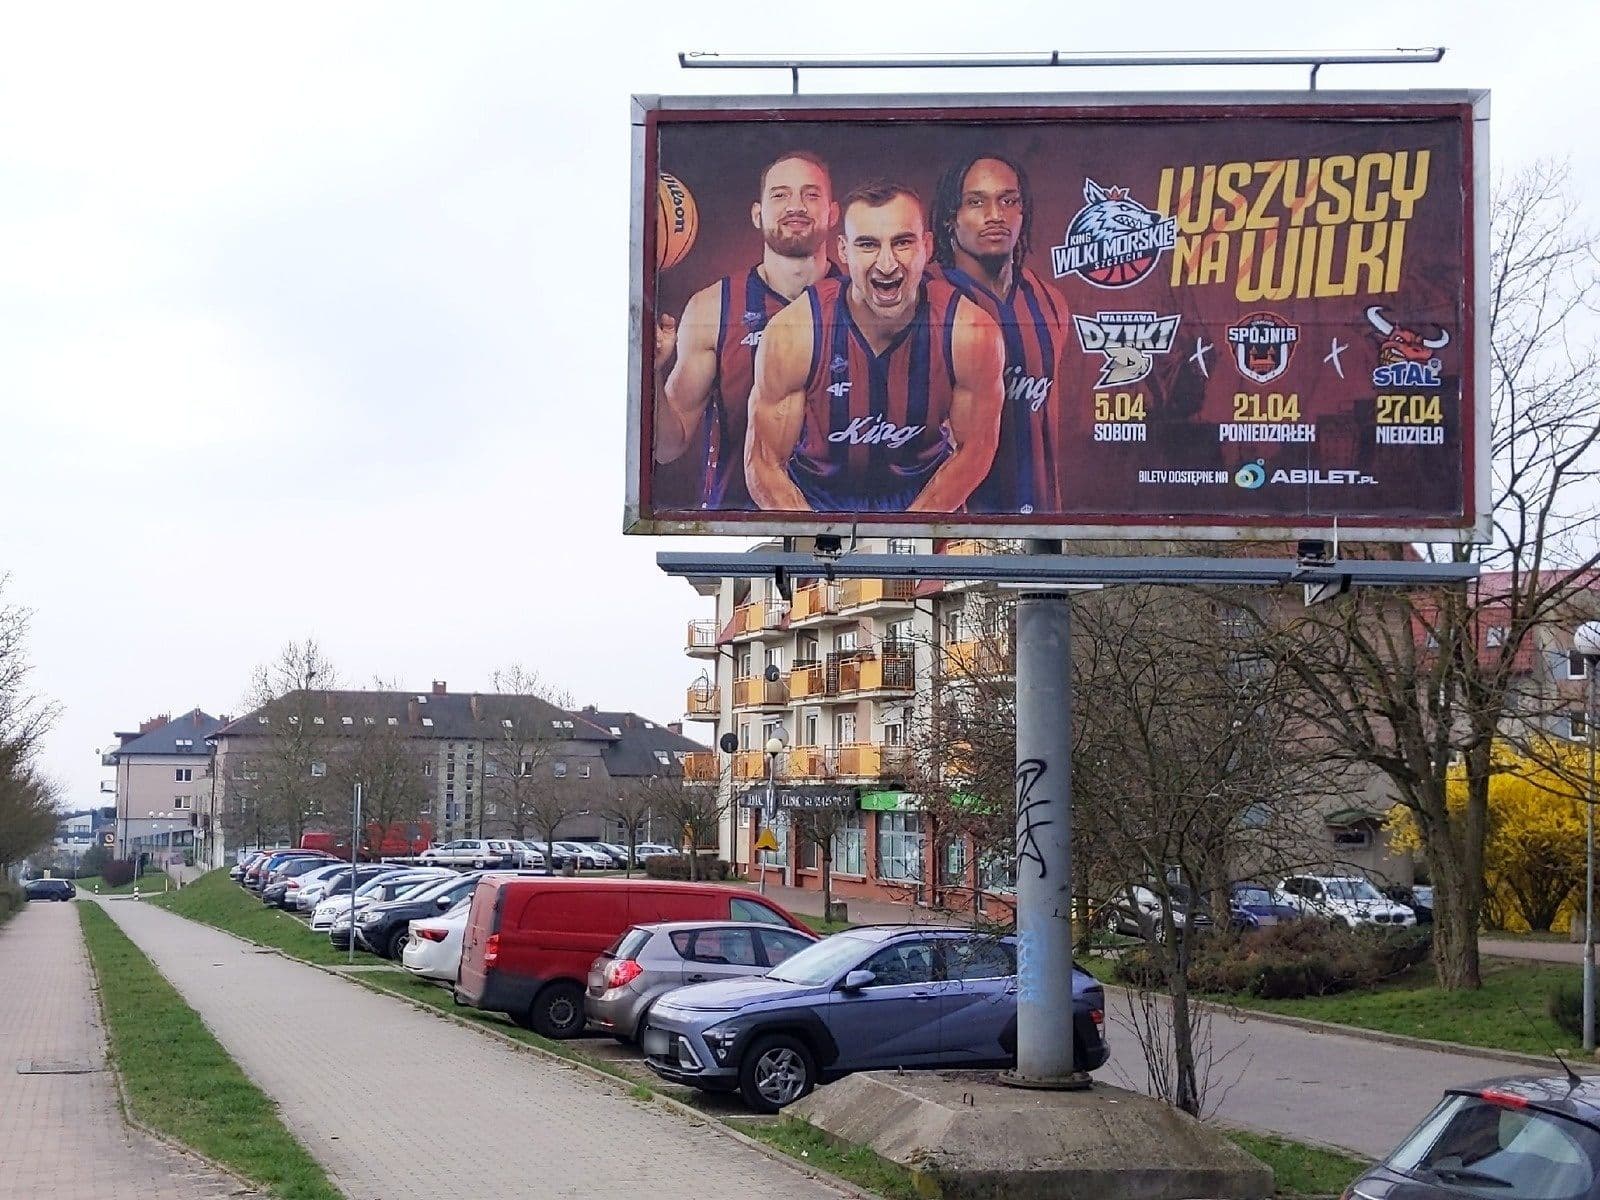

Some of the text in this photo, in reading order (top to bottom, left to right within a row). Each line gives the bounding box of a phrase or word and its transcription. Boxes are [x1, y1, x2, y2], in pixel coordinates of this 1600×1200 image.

[1157, 150, 1430, 234] WSZYSCY
[1055, 220, 1175, 274] WILKI MORSKIE
[1070, 232, 1092, 246] KING
[1094, 250, 1143, 269] SZCZECIN
[1171, 220, 1405, 303] NA WILKI
[1101, 314, 1153, 323] WARSZAWA
[1078, 319, 1176, 350] DZIKI
[1228, 326, 1298, 344] SPÓJNIA
[1373, 361, 1441, 386] STAL
[826, 382, 852, 396] 4F
[1094, 393, 1146, 421] 5.04
[1233, 393, 1301, 422] 21.04
[1376, 395, 1443, 424] 27.04
[828, 413, 926, 449] King
[1094, 423, 1147, 441] SOBOTA
[1219, 423, 1316, 442] PONIEDZIAŁEK
[1375, 426, 1444, 444] NIEDZIELA
[1138, 470, 1229, 486] BILETY DOSTĘPNE NA
[1271, 469, 1379, 484] ABILET.PL
